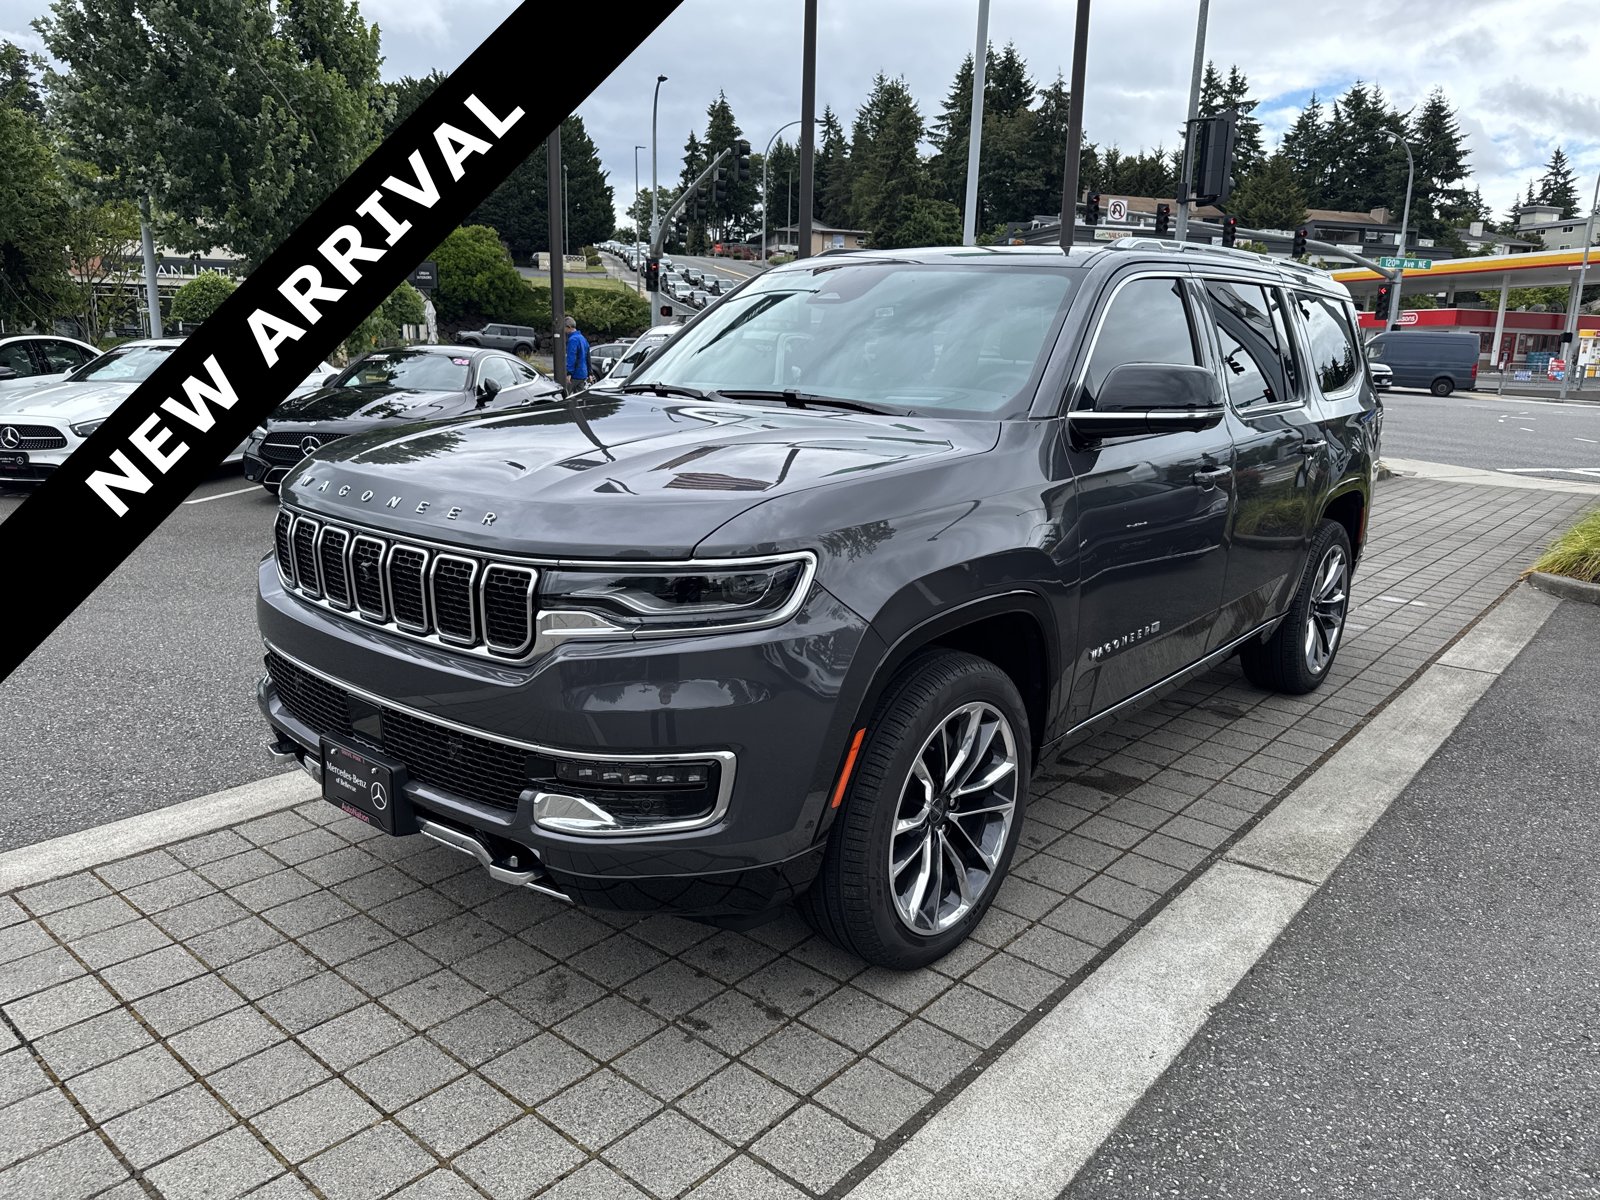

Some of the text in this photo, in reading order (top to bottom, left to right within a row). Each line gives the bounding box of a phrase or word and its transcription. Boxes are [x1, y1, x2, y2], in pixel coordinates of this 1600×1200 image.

[1403, 260, 1415, 268] Ave
[1418, 260, 1427, 269] NE
[300, 475, 497, 526] WAGONEER
[1090, 626, 1150, 659] WAGONEER
[326, 761, 367, 788] Mercedes-Benz
[341, 802, 370, 823] AutoNation
